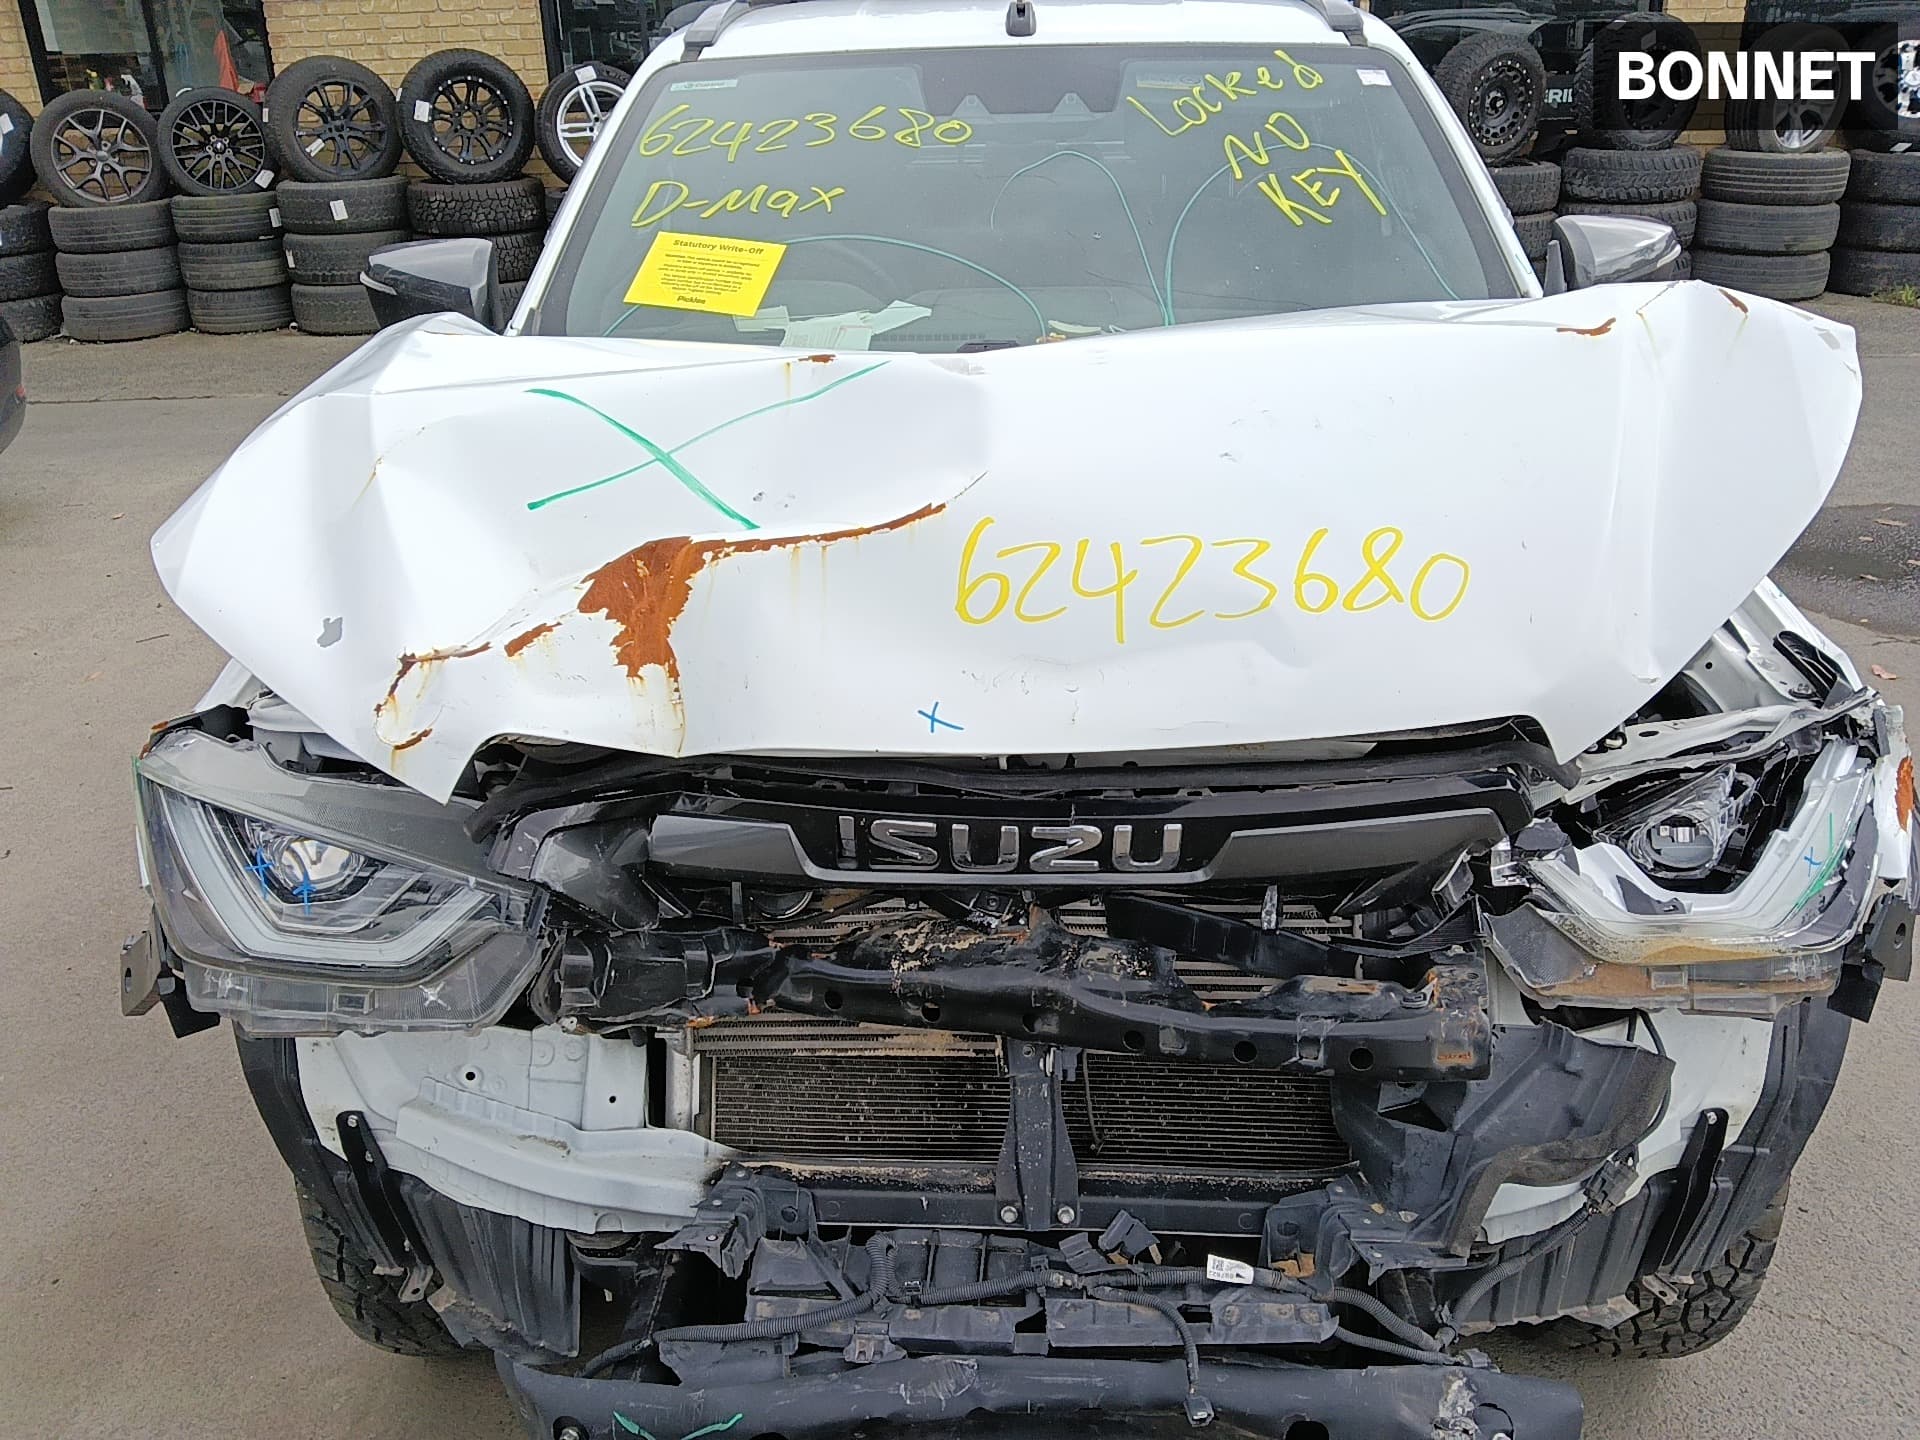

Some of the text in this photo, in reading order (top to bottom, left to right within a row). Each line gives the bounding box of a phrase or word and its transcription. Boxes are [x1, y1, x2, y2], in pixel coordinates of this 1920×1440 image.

[1126, 49, 1324, 136] Locked
[639, 103, 974, 163] 62423680
[1224, 111, 1310, 181] NO
[631, 179, 846, 229] D-Max
[1257, 148, 1388, 226] KEY
[673, 239, 764, 255] Statutory Write-Off
[954, 515, 1472, 645] 62423680
[836, 814, 1184, 873] ISUZU
